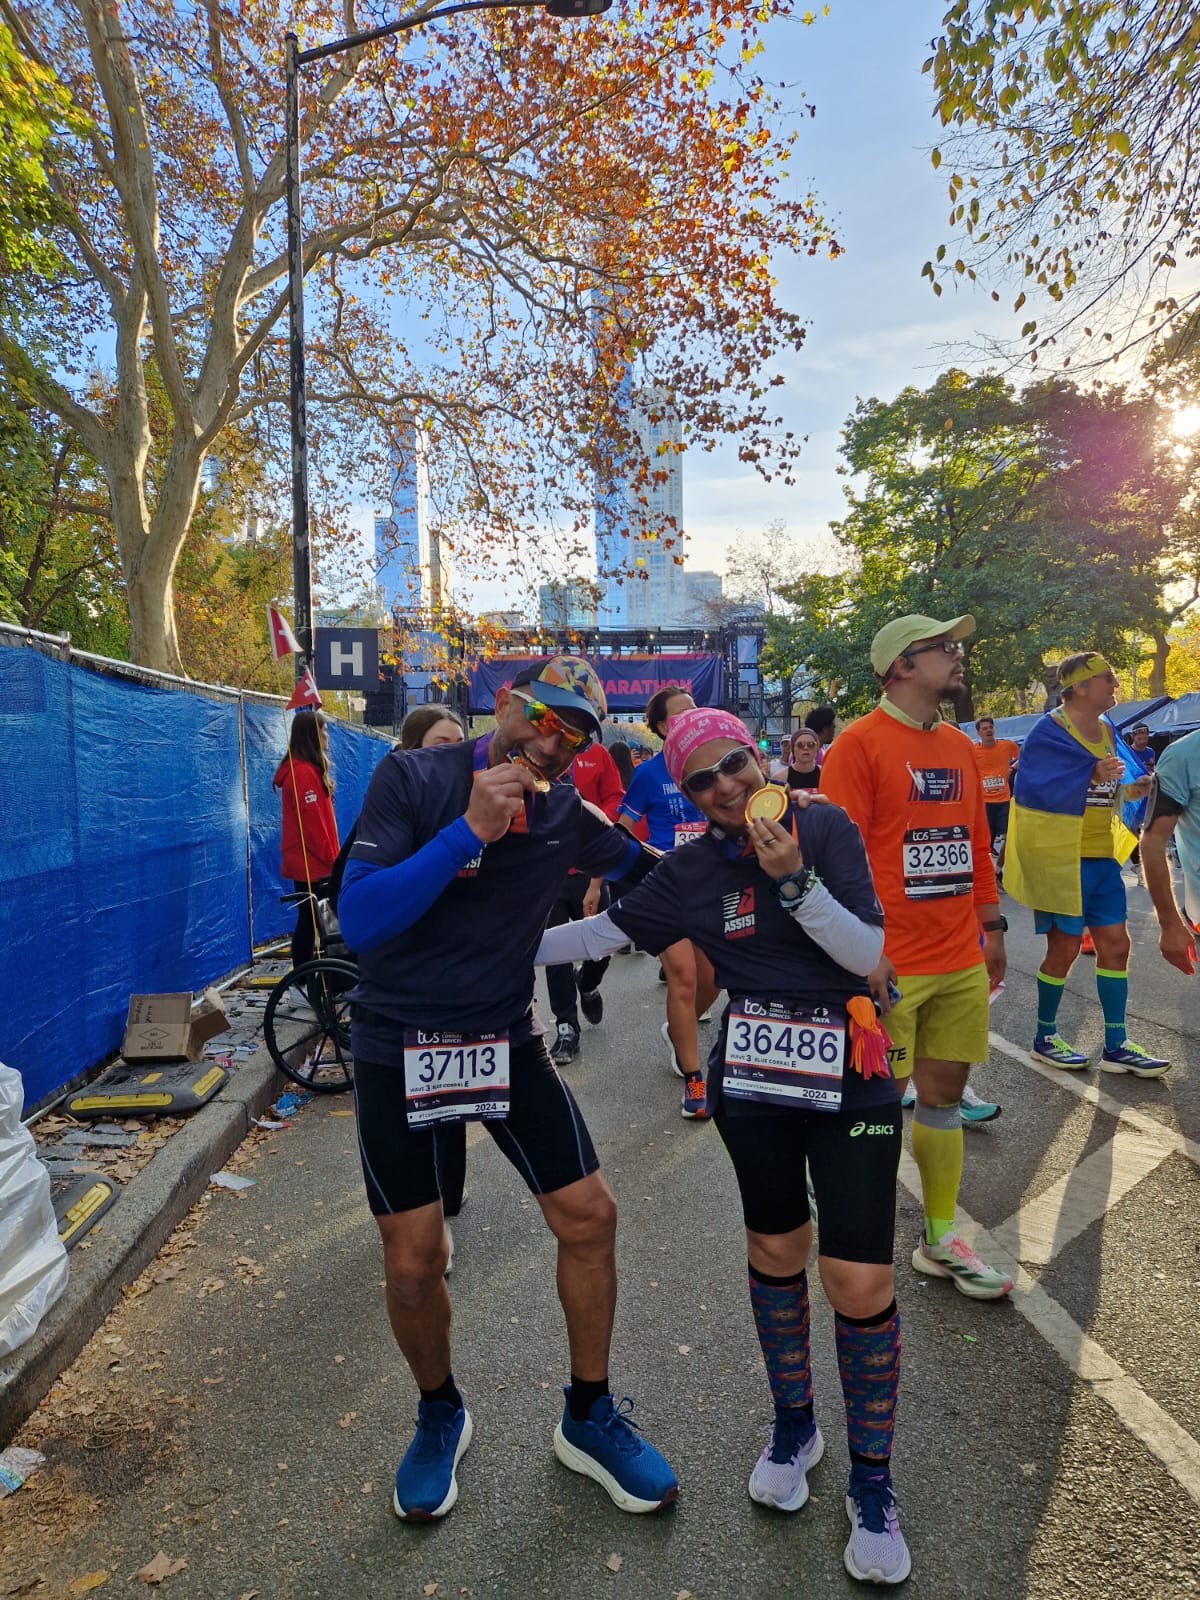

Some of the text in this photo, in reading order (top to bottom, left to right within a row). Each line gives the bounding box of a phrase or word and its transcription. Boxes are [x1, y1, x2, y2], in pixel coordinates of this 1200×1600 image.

[330, 641, 363, 676] H
[912, 830, 929, 841] tcs
[908, 843, 969, 868] 32366
[724, 913, 756, 934] ASSISI
[744, 999, 767, 1017] tcs
[811, 1016, 831, 1024] TATA
[417, 1029, 440, 1045] tcs
[480, 1033, 496, 1041] TATA
[733, 1021, 838, 1064] 36486
[418, 1046, 496, 1083] 37113
[746, 1054, 752, 1062] 3
[791, 1060, 797, 1068] E
[425, 1084, 431, 1092] 3
[464, 1080, 470, 1088] E
[802, 1088, 828, 1100] 2024
[474, 1103, 497, 1112] 2024
[866, 1124, 894, 1135] asics
